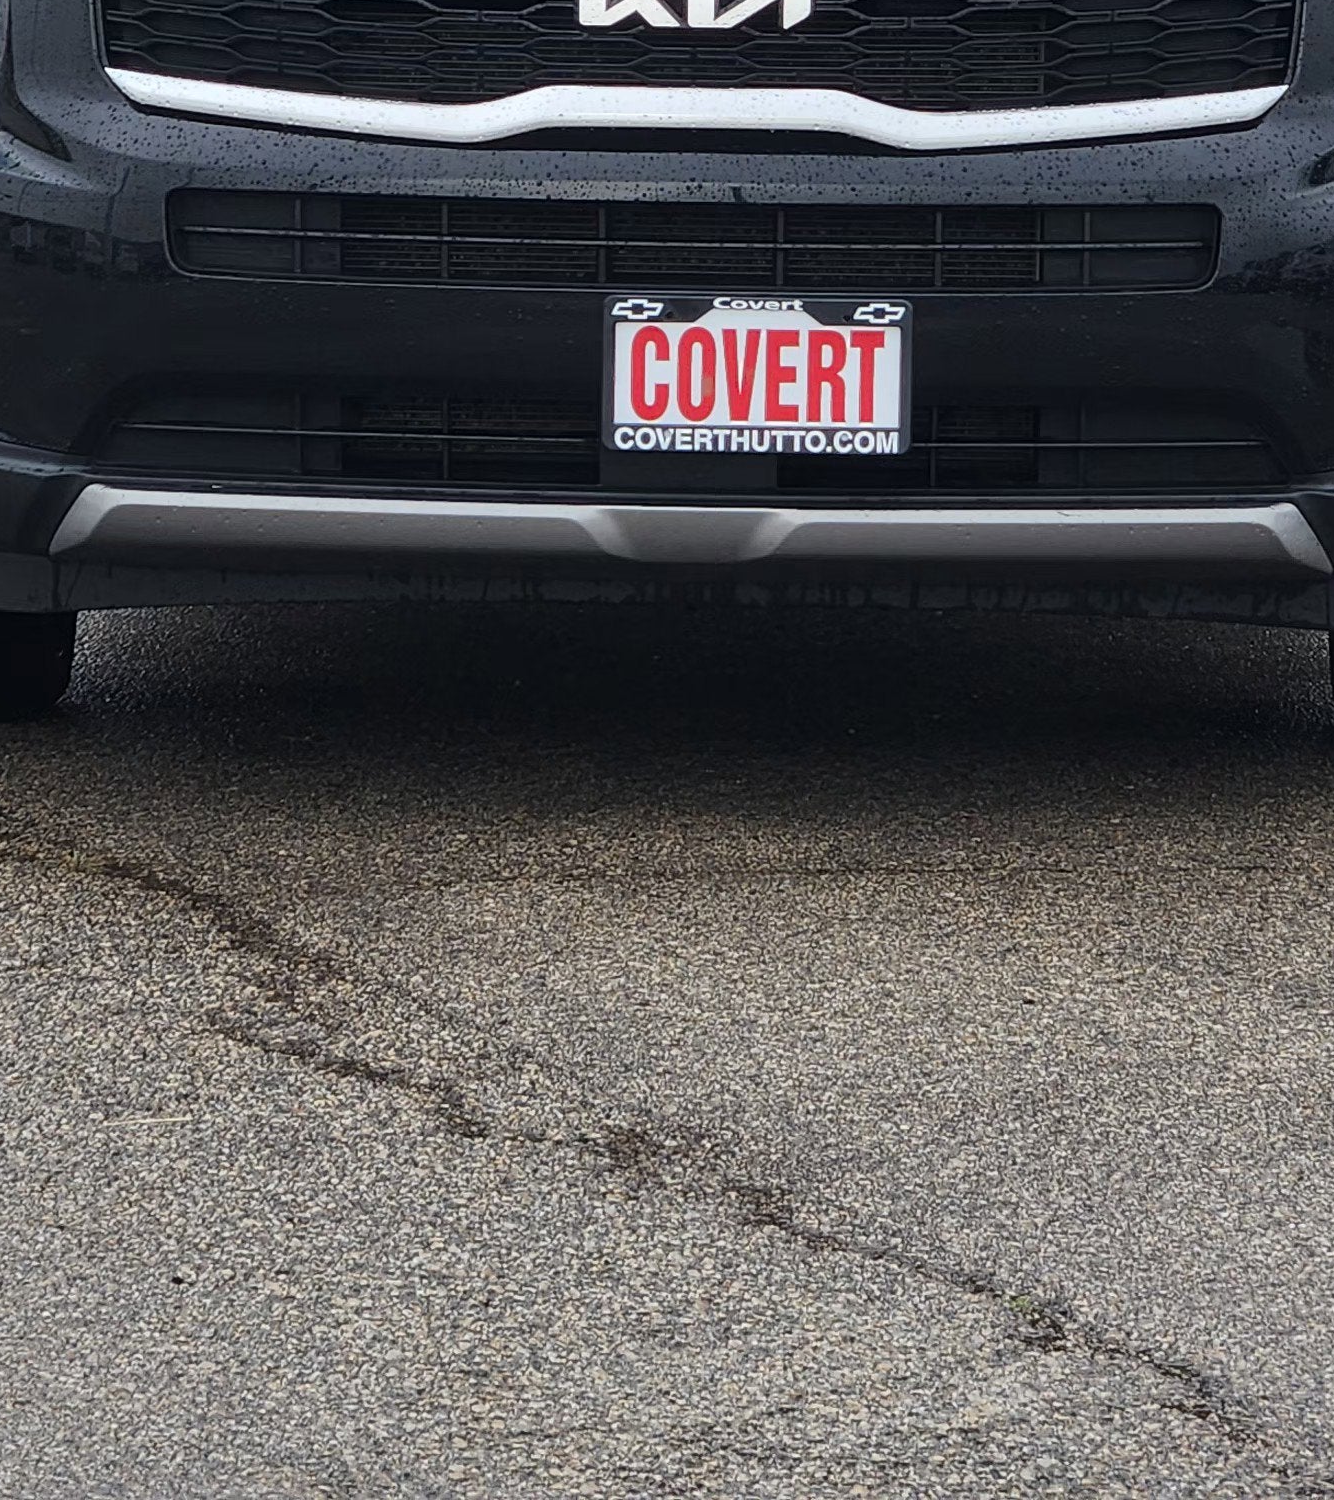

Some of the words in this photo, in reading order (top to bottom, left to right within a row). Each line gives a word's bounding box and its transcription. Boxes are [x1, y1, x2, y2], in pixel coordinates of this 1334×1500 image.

[712, 296, 805, 312] Covert
[630, 325, 886, 424] COVERT
[613, 427, 900, 454] COVERTHUTTO.COM
